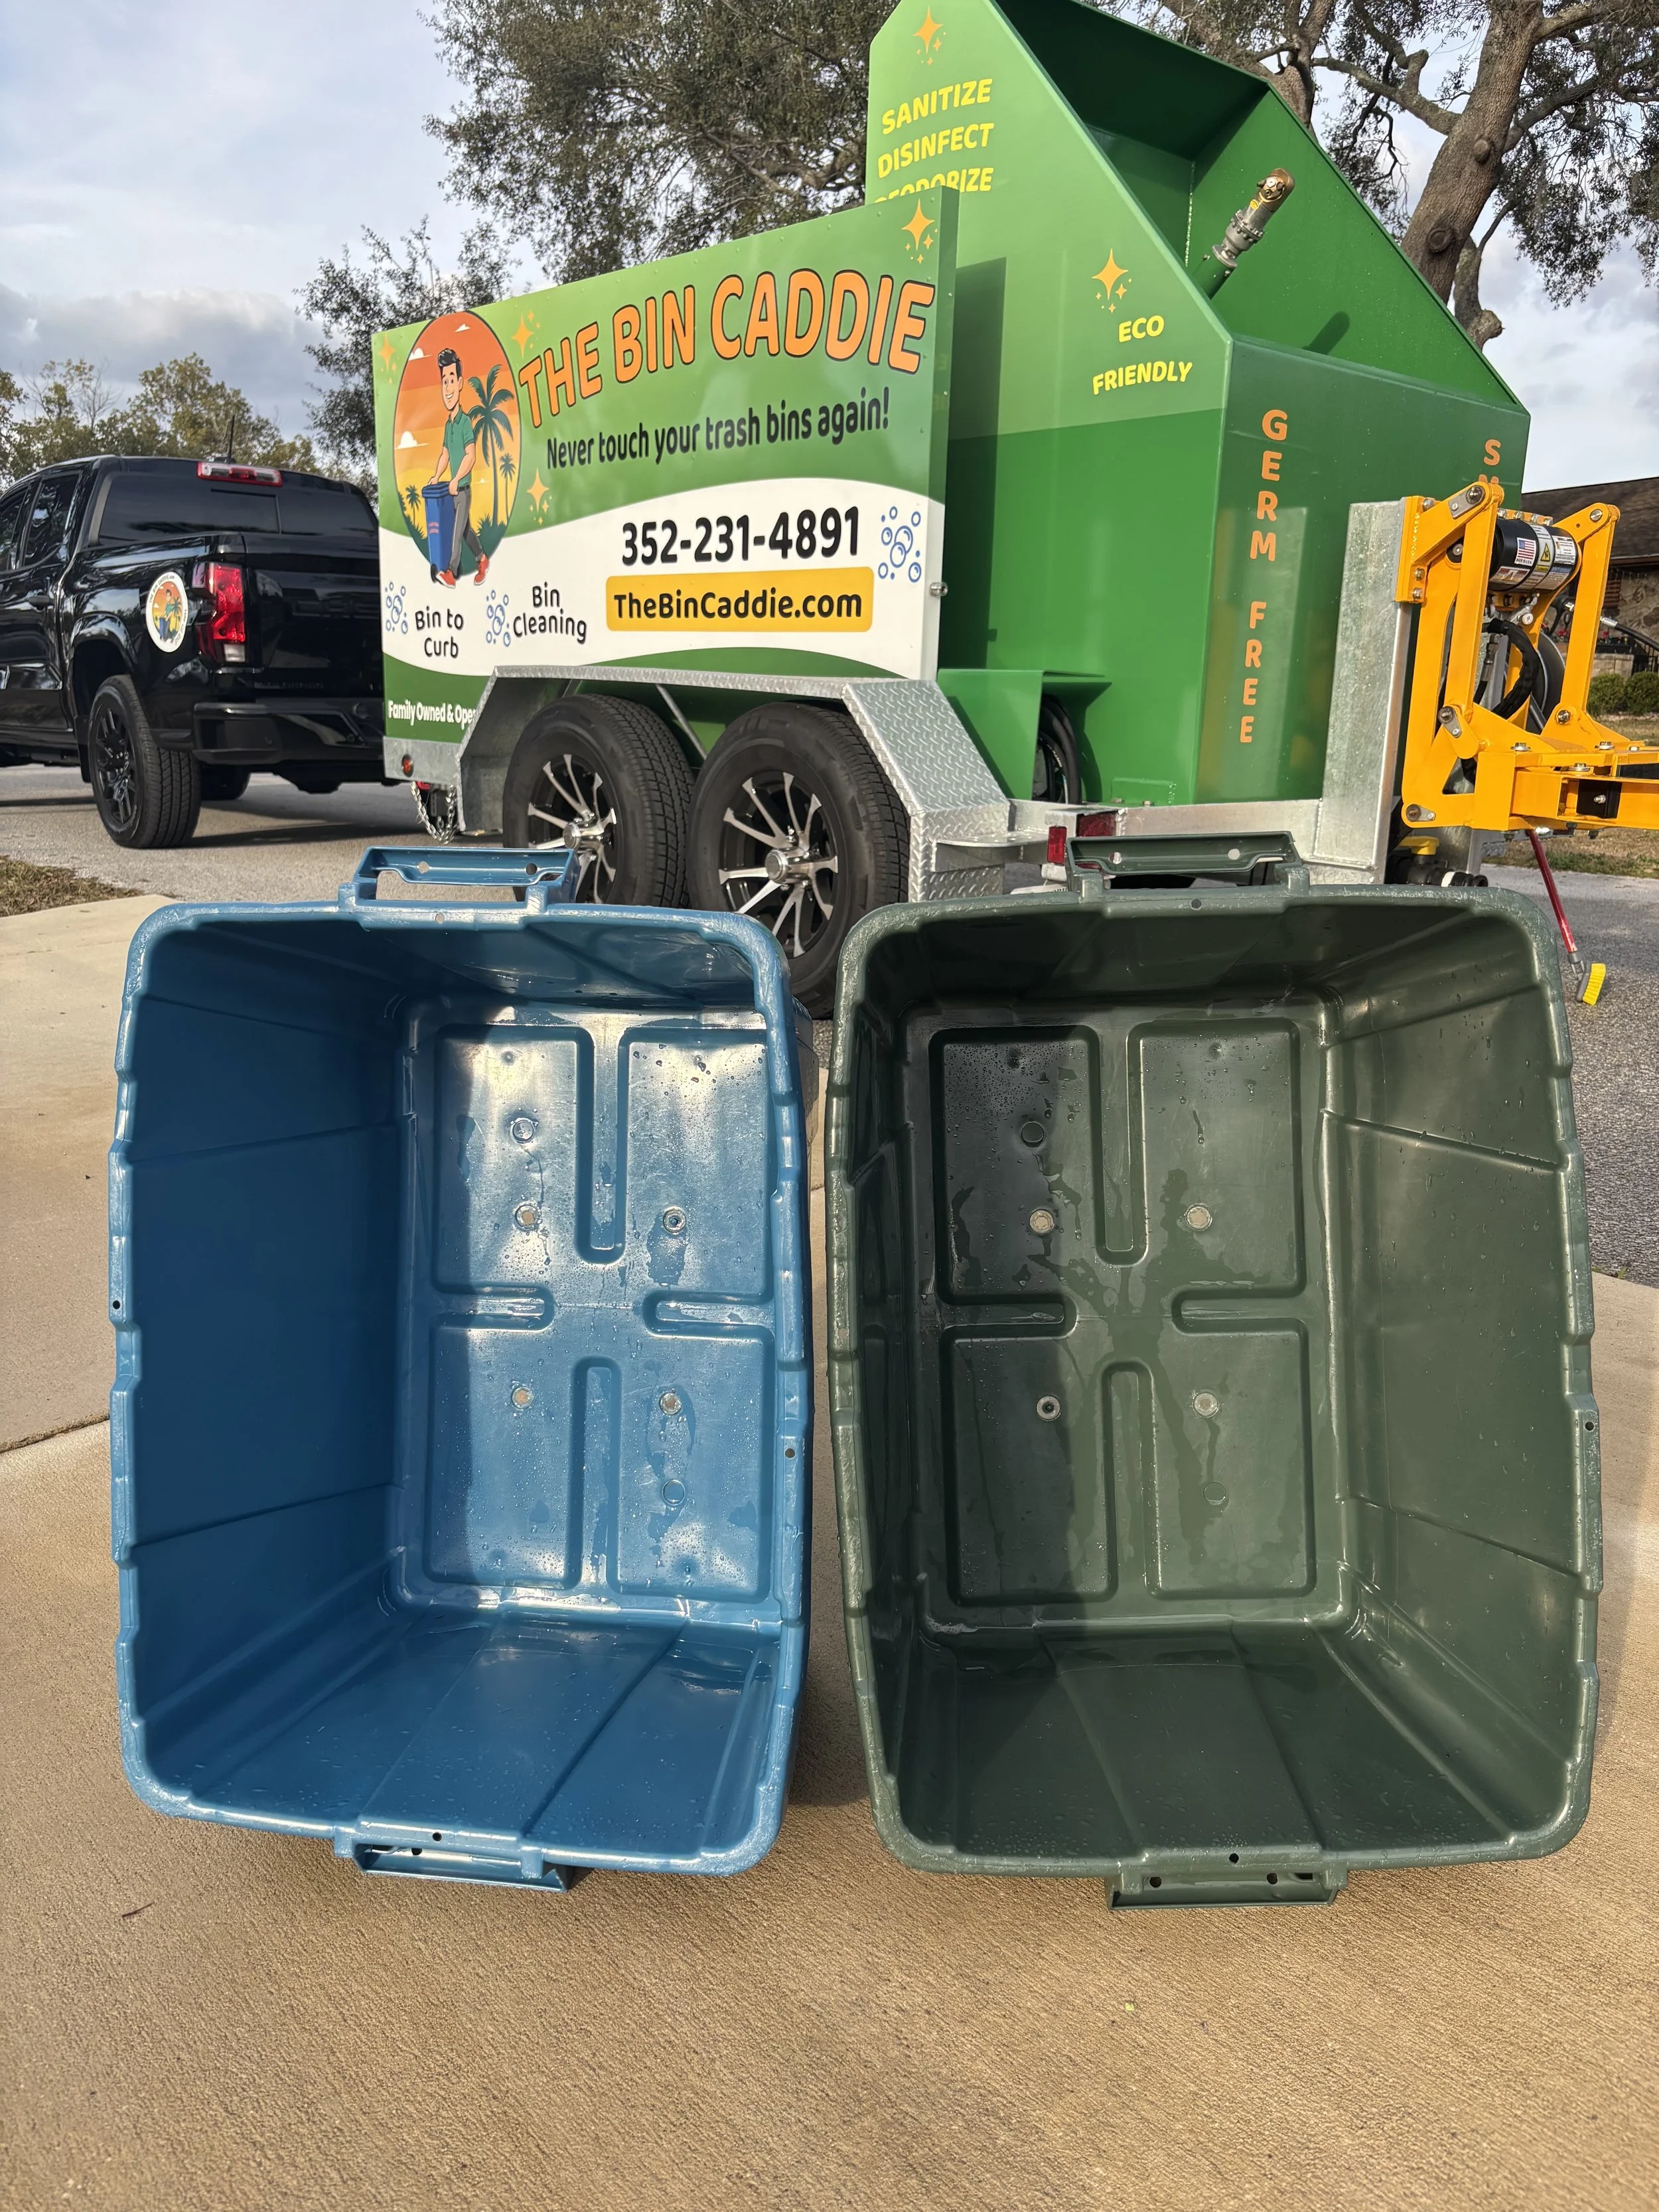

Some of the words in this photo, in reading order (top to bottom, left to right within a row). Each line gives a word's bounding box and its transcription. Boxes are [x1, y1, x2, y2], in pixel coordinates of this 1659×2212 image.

[882, 78, 993, 135] SANITIZE
[878, 123, 994, 179] DISINFECT
[1118, 315, 1165, 343] ECO
[519, 321, 603, 429] THE
[613, 285, 695, 384] BIN
[711, 268, 936, 374] CADDIE
[1092, 361, 1192, 396] FRIENDLY
[547, 437, 593, 470] Never
[599, 422, 650, 461] touch
[655, 421, 701, 465] your
[705, 407, 761, 451] trash
[766, 400, 812, 441] bins
[818, 386, 890, 445] again!
[1250, 409, 1288, 561] GERM
[622, 506, 859, 567] 352-231-4891
[532, 581, 560, 607] Bin
[614, 587, 863, 621] TheBinCaddie.com
[415, 605, 441, 630] Bin
[447, 609, 464, 630] to
[513, 608, 587, 644] Cleaning
[424, 636, 459, 658] Curb
[1240, 601, 1266, 743] FREE
[388, 699, 415, 726] Family
[416, 701, 445, 722] Owned
[447, 703, 454, 723] &
